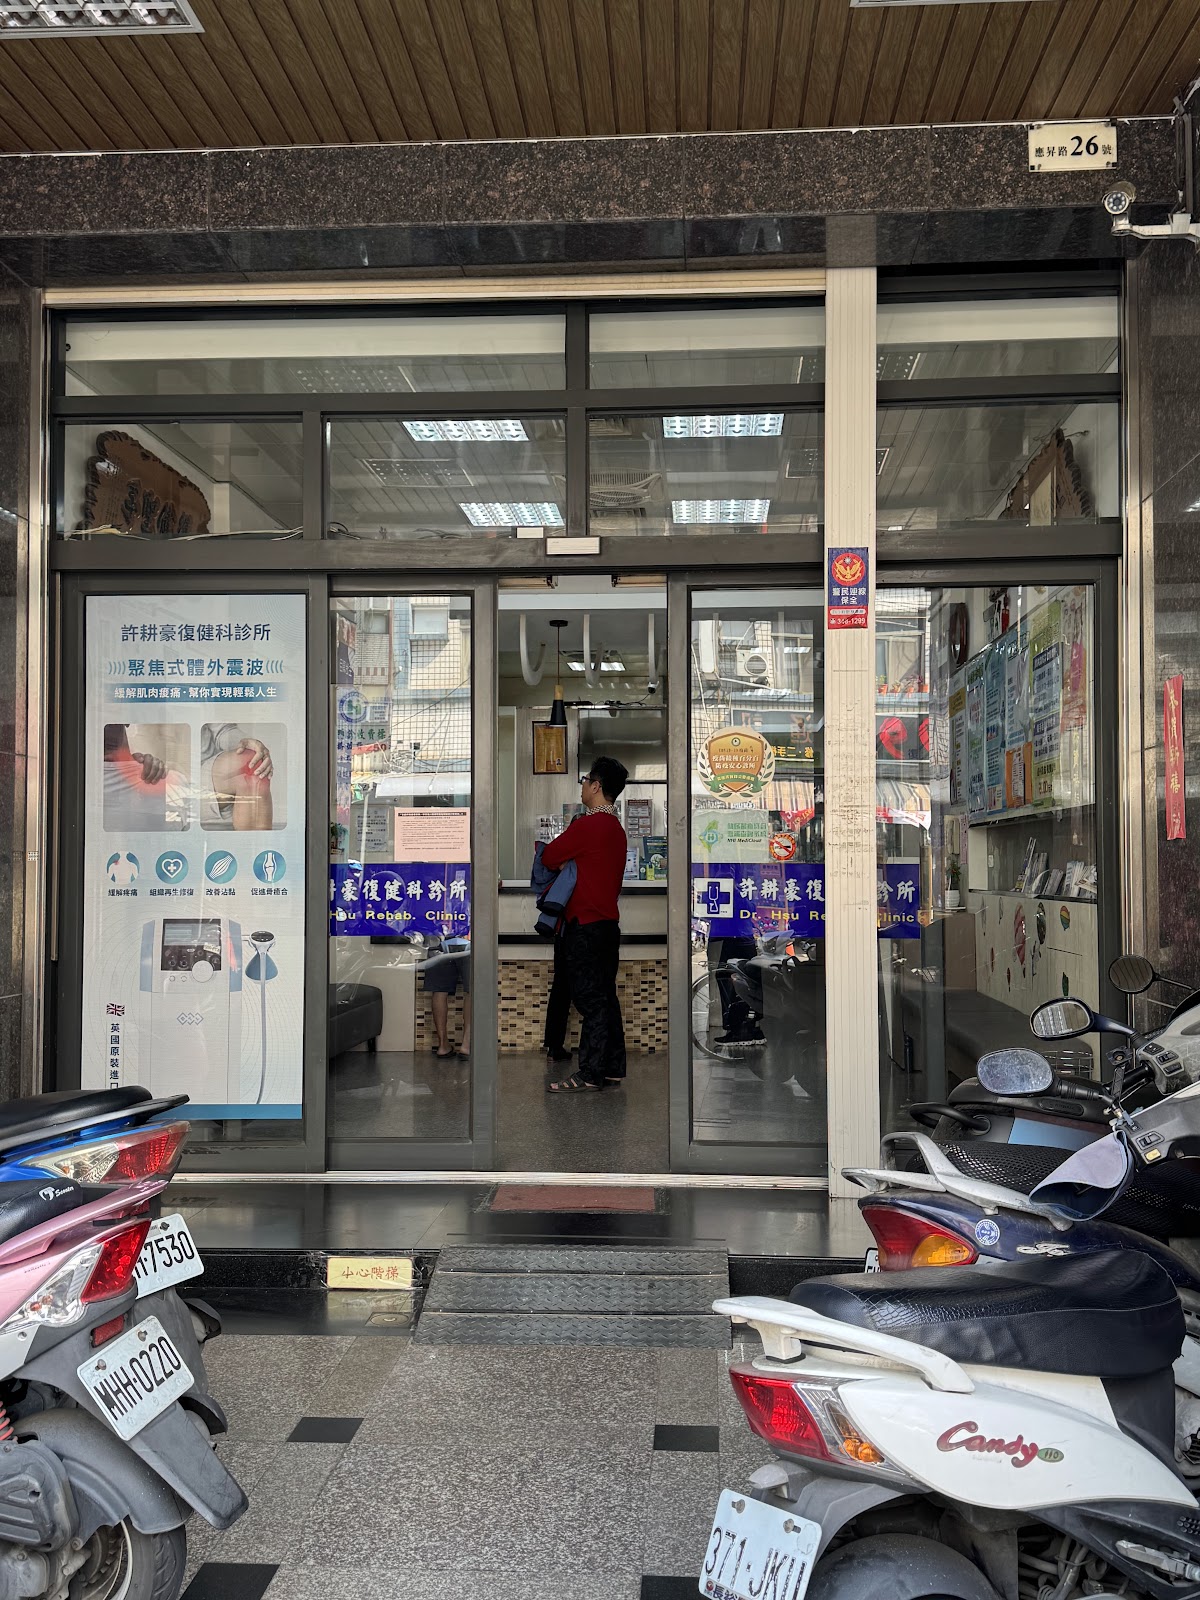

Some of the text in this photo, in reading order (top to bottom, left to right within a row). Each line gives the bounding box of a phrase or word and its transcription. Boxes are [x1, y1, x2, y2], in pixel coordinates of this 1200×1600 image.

[121, 623, 271, 642] 許耕豪復健科診所
[128, 658, 264, 677] 聚焦式體外震波
[149, 888, 194, 896] 組織再生修復
[365, 911, 416, 920] Rehab.
[425, 911, 466, 920] Clinic
[740, 910, 761, 920] Dr.
[771, 911, 799, 920] Hsu
[877, 912, 915, 922] linic
[341, 1266, 399, 1280] 小心階梯
[93, 1336, 182, 1421] MHH-0220
[937, 1421, 1039, 1468] Candy
